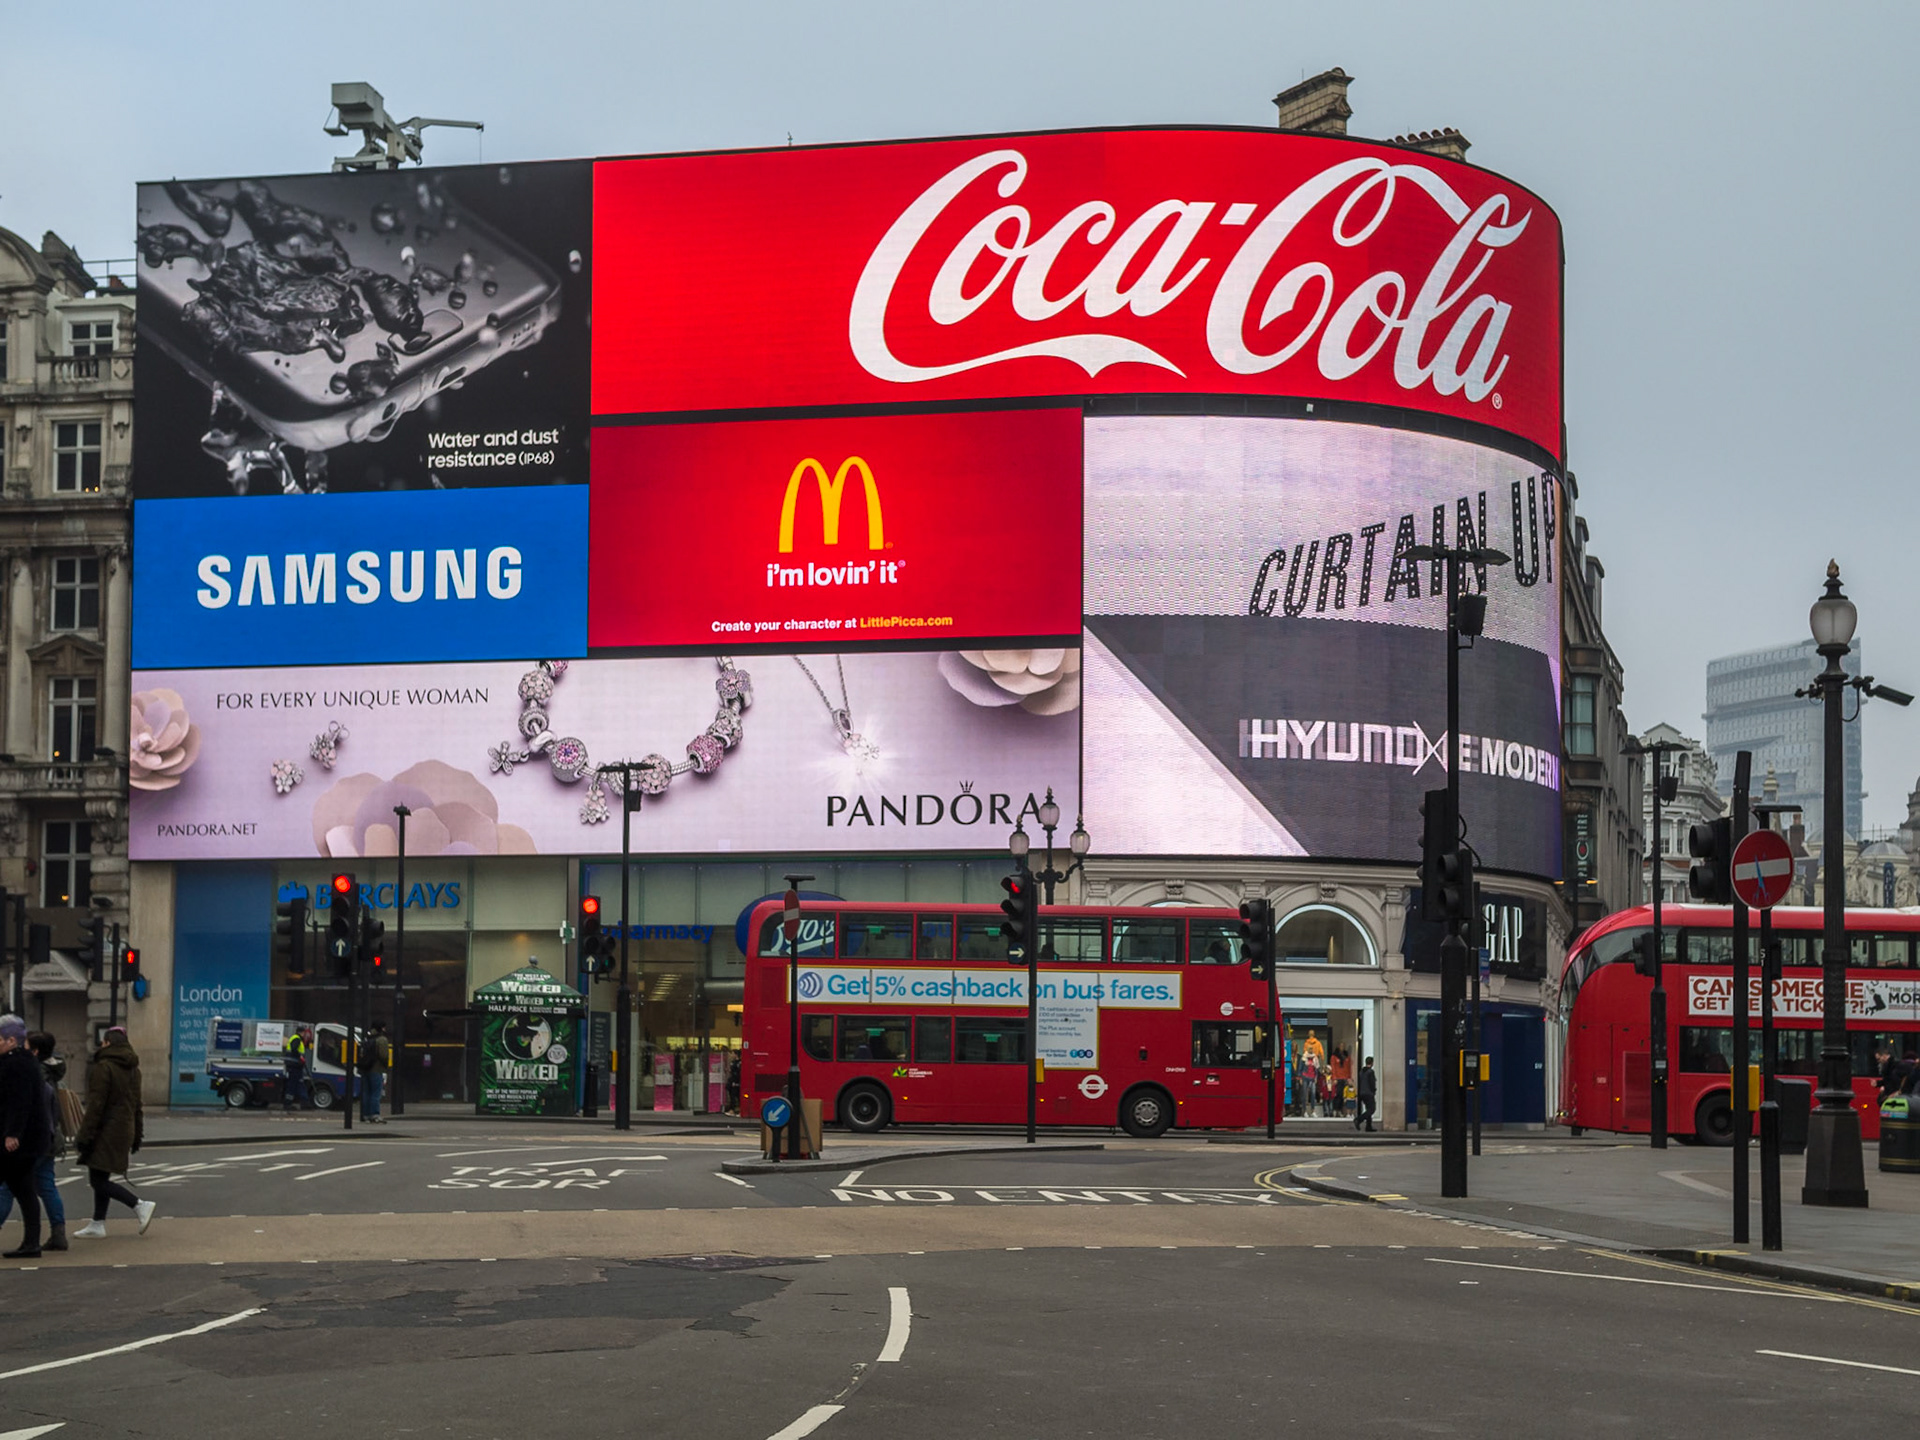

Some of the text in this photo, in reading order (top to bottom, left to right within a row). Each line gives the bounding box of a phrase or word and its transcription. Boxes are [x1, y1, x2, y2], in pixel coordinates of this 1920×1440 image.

[849, 149, 1532, 403] Coca-Cola
[428, 428, 559, 449] Water and dust
[428, 450, 555, 468] resistance (IP68)
[1248, 471, 1555, 618] CURTAIN UP
[197, 545, 523, 609] SAMSUNG
[767, 562, 804, 587] i'm
[808, 560, 876, 586] lovin'
[711, 615, 953, 633] Create your character at LittlePicca.com
[216, 688, 490, 710] FOR EVERY UNIQUE WOMAN
[826, 792, 1043, 828] PANDORA
[157, 823, 258, 838] PANDORA.NET
[314, 881, 461, 910] BRCLAYS
[1482, 903, 1523, 963] GAP
[180, 984, 242, 1001] London
[827, 974, 869, 996] Get
[875, 975, 906, 997] 5%
[911, 976, 1023, 998] cashback
[1063, 979, 1105, 1000] bus
[1110, 979, 1174, 1000] fares.
[179, 1006, 209, 1016] Switch
[210, 1007, 219, 1016] to
[1693, 997, 1729, 1010] GET
[179, 1021, 191, 1029] up
[193, 1019, 202, 1028] to
[179, 1031, 198, 1040] with
[831, 1188, 1279, 1204] NO ENTRY
